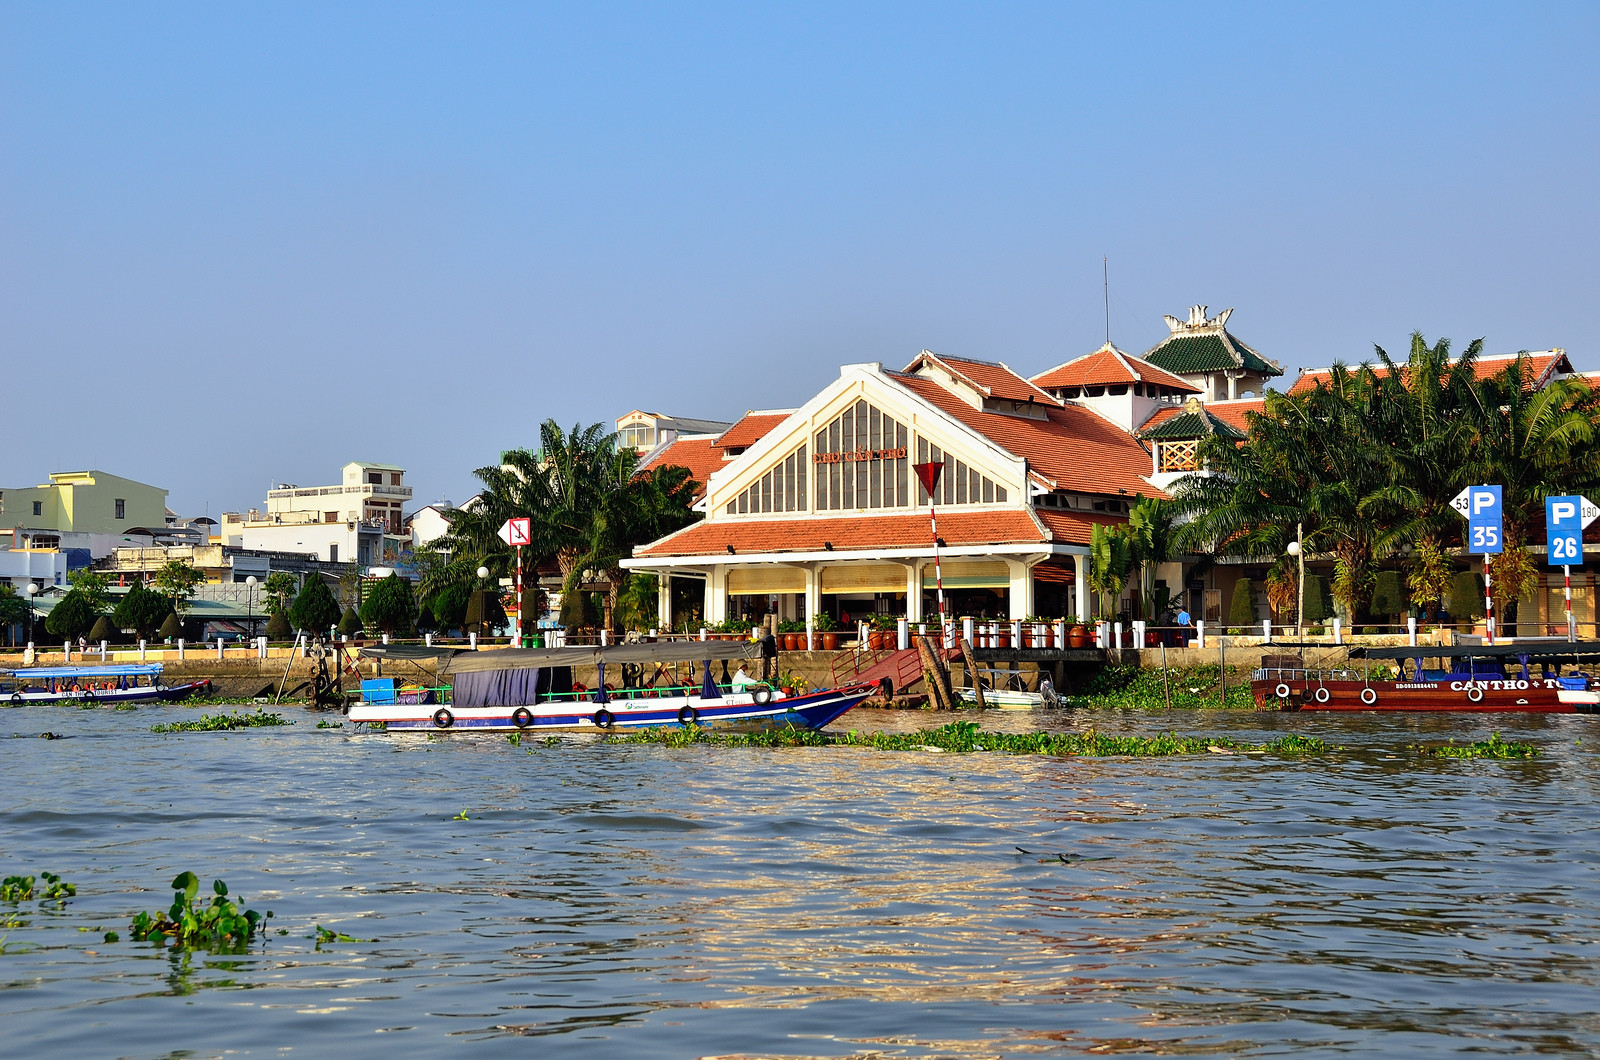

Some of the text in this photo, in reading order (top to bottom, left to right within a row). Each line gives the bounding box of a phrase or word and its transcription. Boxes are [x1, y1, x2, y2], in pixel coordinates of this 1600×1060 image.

[812, 450, 840, 465] CHỢ
[877, 446, 906, 459] THƠ
[1456, 498, 1469, 510] 53
[1474, 492, 1495, 514] P
[1582, 506, 1597, 518] 180
[1552, 503, 1575, 524] P
[1473, 526, 1498, 547] 35
[1552, 537, 1577, 558] 26
[1450, 680, 1529, 691] CANTHO
